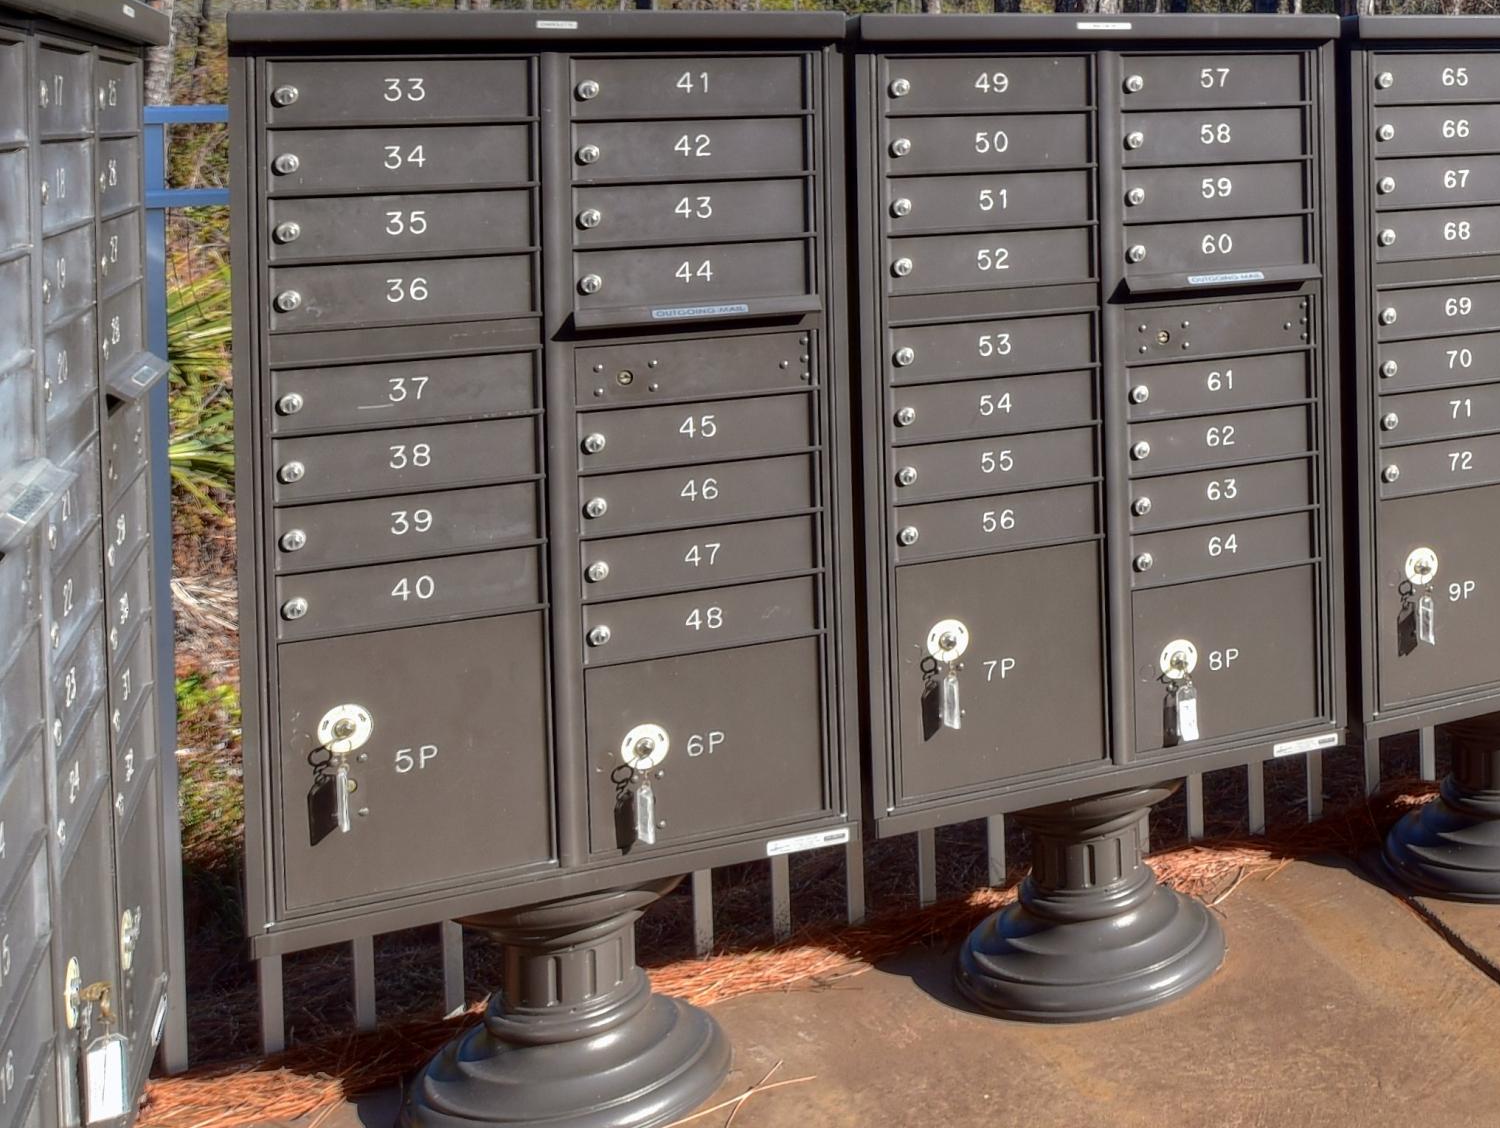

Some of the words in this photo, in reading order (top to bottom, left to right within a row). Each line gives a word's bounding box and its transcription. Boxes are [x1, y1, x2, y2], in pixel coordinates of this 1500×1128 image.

[677, 72, 707, 93] 41
[975, 73, 1008, 92] 49
[1201, 68, 1229, 88] 57
[1442, 68, 1468, 86] 65
[55, 76, 63, 106] 17
[384, 79, 425, 101] 33
[1201, 124, 1230, 144] 58
[1443, 120, 1469, 137] 66
[675, 135, 711, 156] 42
[976, 131, 1008, 153] 50
[385, 145, 425, 169] 34
[57, 168, 65, 198] 18
[1202, 178, 1232, 198] 59
[1444, 170, 1469, 188] 67
[675, 197, 712, 218] 43
[980, 189, 1006, 210] 51
[386, 211, 426, 235] 35
[1444, 221, 1470, 240] 68
[1202, 234, 1232, 254] 60
[978, 248, 1009, 270] 52
[57, 258, 65, 288] 19
[676, 260, 712, 282] 44
[387, 278, 427, 302] 36
[655, 307, 715, 318] OUTGOING
[719, 305, 746, 313] MAIL
[1446, 297, 1471, 316] 69
[980, 334, 1011, 356] 53
[1447, 349, 1472, 368] 70
[389, 377, 428, 401] 37
[1208, 370, 1232, 391] 61
[980, 393, 1011, 415] 54
[1450, 399, 1470, 418] 71
[680, 415, 716, 437] 45
[1207, 426, 1234, 446] 62
[390, 444, 430, 468] 38
[982, 450, 1013, 472] 55
[1449, 452, 1472, 471] 72
[681, 478, 718, 501] 46
[1207, 479, 1237, 500] 63
[62, 491, 70, 521] 21
[392, 510, 432, 534] 39
[983, 510, 1014, 532] 56
[685, 543, 720, 566] 47
[1209, 534, 1237, 556] 64
[64, 579, 72, 616] 22
[392, 576, 434, 600] 40
[1449, 581, 1475, 601] 9P
[686, 607, 722, 630] 48
[984, 658, 1015, 681] 7P
[1209, 649, 1238, 670] 8P
[687, 732, 724, 756] 6P
[395, 745, 437, 772] 5P
[0, 1050, 14, 1103] 16
